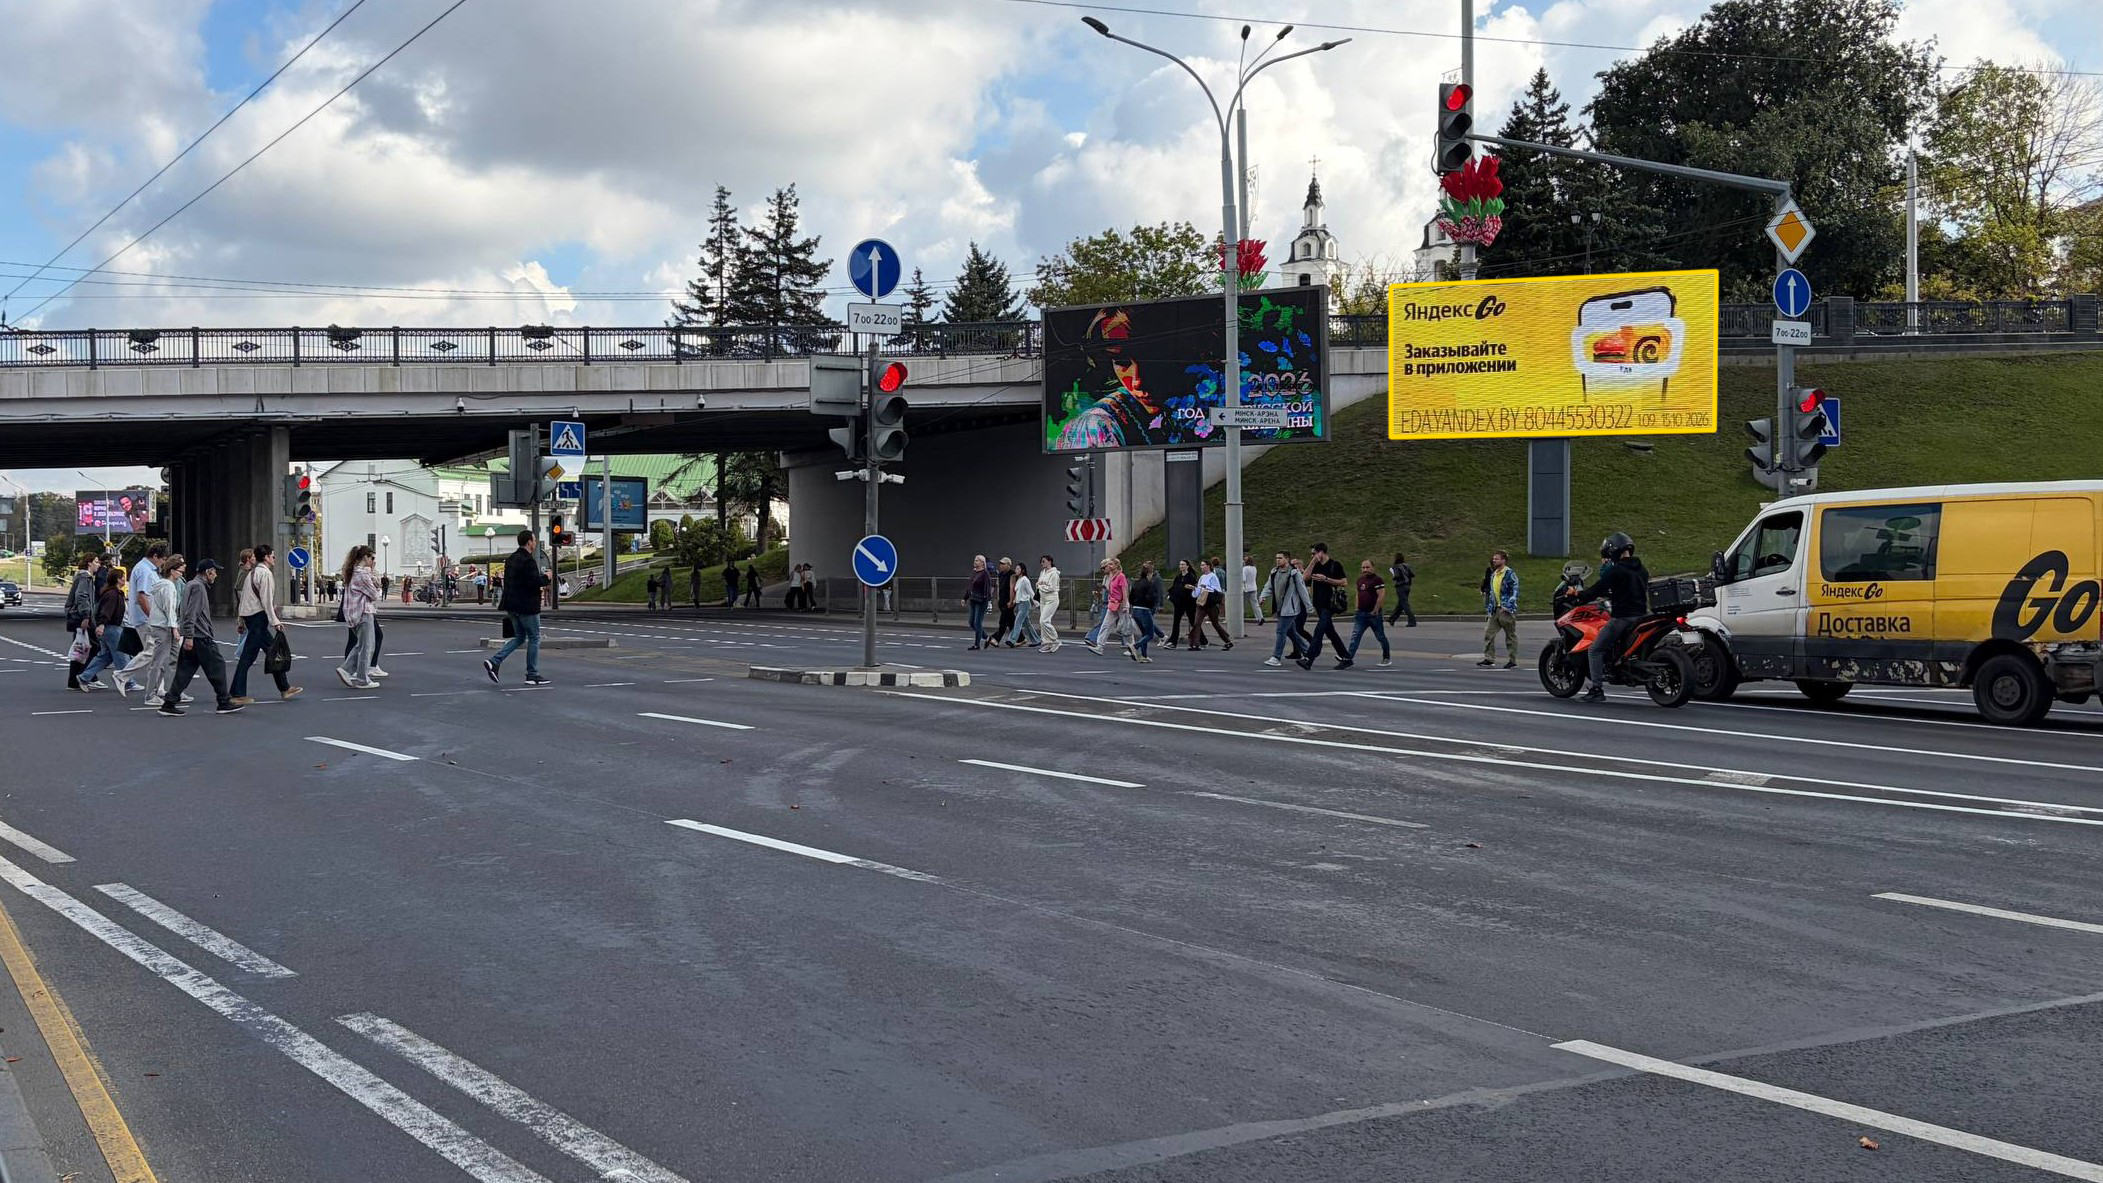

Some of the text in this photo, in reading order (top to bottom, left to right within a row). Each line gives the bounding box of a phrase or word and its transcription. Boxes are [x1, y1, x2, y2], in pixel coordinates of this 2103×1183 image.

[1404, 295, 1506, 321] Яндекс Go
[1404, 340, 1507, 359] Заказывайте
[1404, 360, 1517, 377] в приложении
[1247, 371, 1314, 398] 2026
[1177, 407, 1206, 420] ГОД
[1524, 405, 1633, 431] 80445530322
[1821, 583, 1883, 600] Яндекс Go
[1992, 550, 2099, 641] Go
[1818, 612, 1911, 637] Доставка
